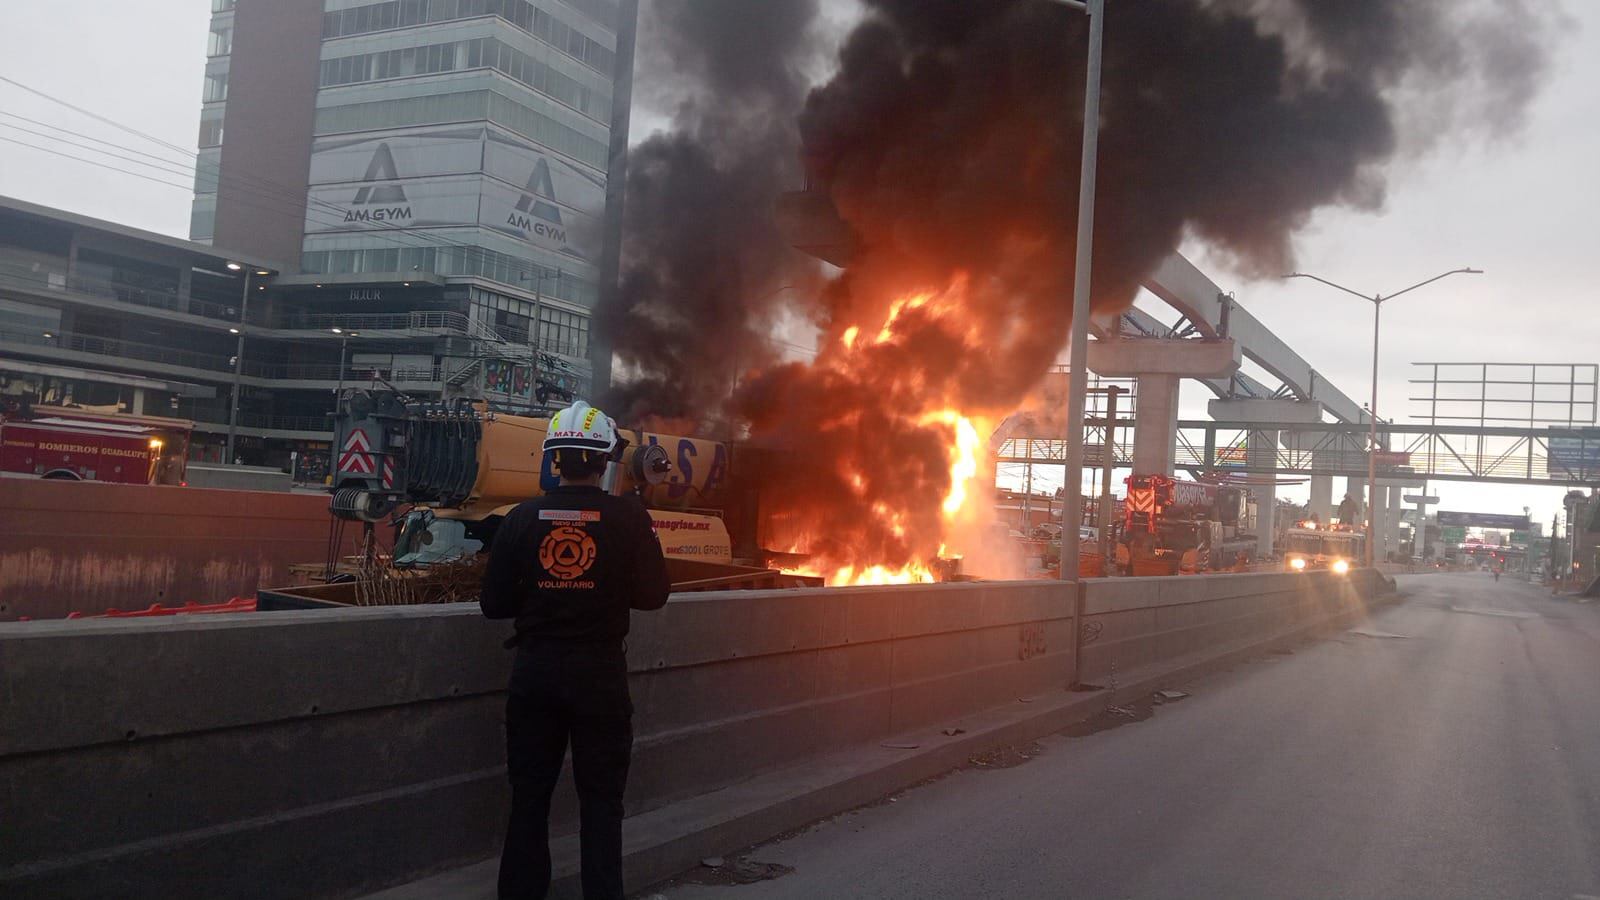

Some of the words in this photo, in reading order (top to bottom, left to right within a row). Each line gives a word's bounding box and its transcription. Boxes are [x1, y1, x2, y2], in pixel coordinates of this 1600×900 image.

[344, 209, 370, 222] AM
[373, 206, 412, 221] GYM
[507, 213, 531, 232] AM
[534, 222, 567, 243] GYM
[554, 430, 584, 438] MATA
[39, 442, 98, 454] BOMBEROS
[101, 447, 149, 459] GUADALUPE
[538, 580, 595, 589] VOLUNTARIO
